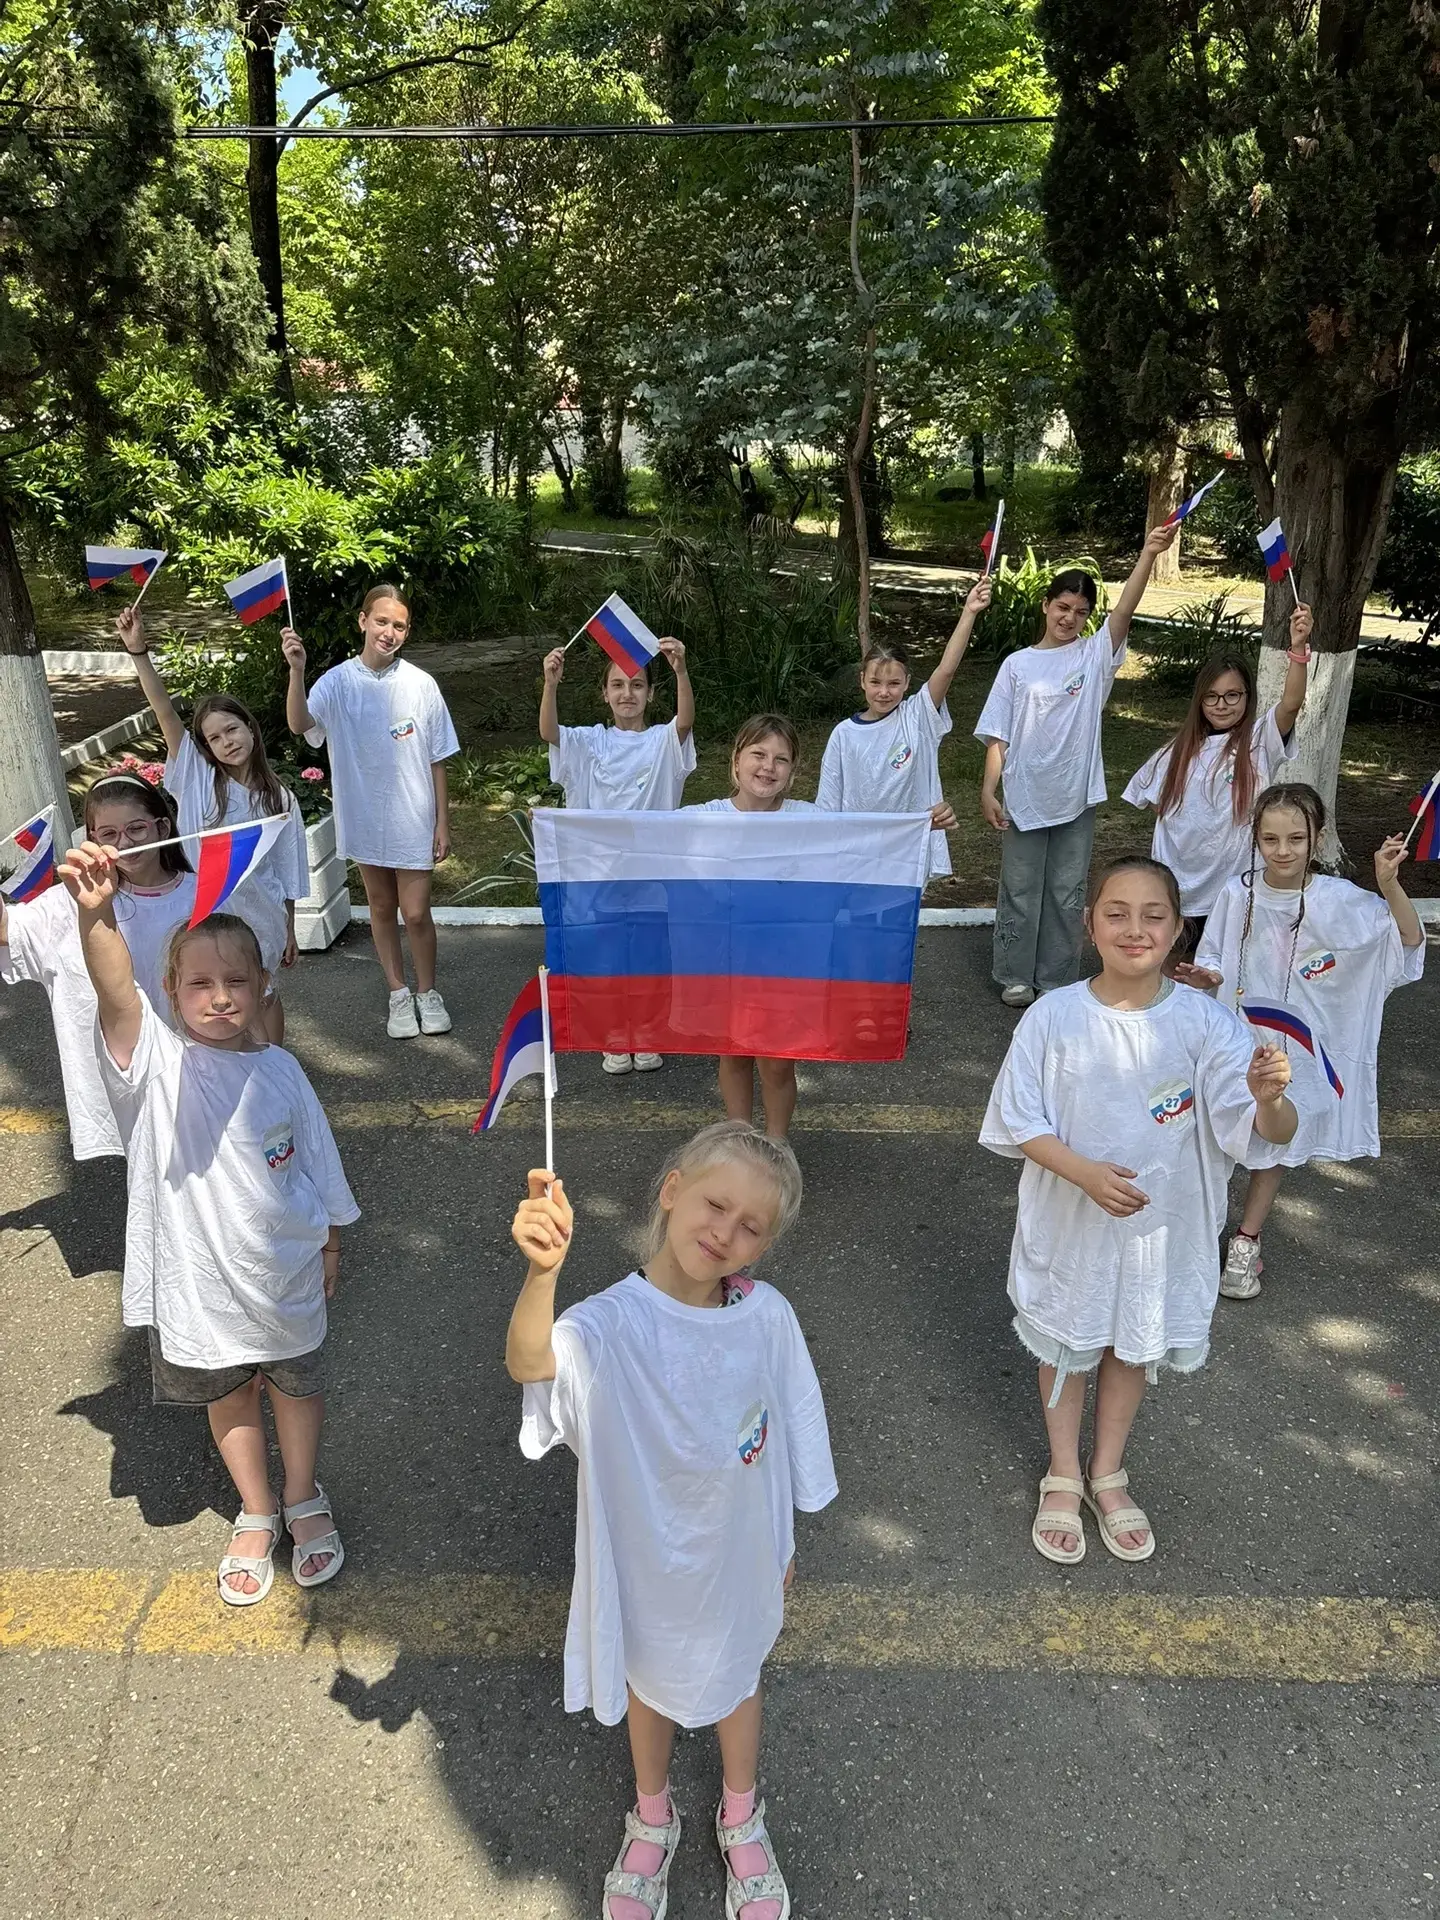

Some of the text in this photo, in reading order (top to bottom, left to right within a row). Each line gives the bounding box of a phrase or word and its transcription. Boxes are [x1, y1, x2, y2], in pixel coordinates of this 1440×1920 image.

[1310, 959, 1322, 968] 27
[1165, 1097, 1180, 1108] 27
[278, 1142, 288, 1153] 27
